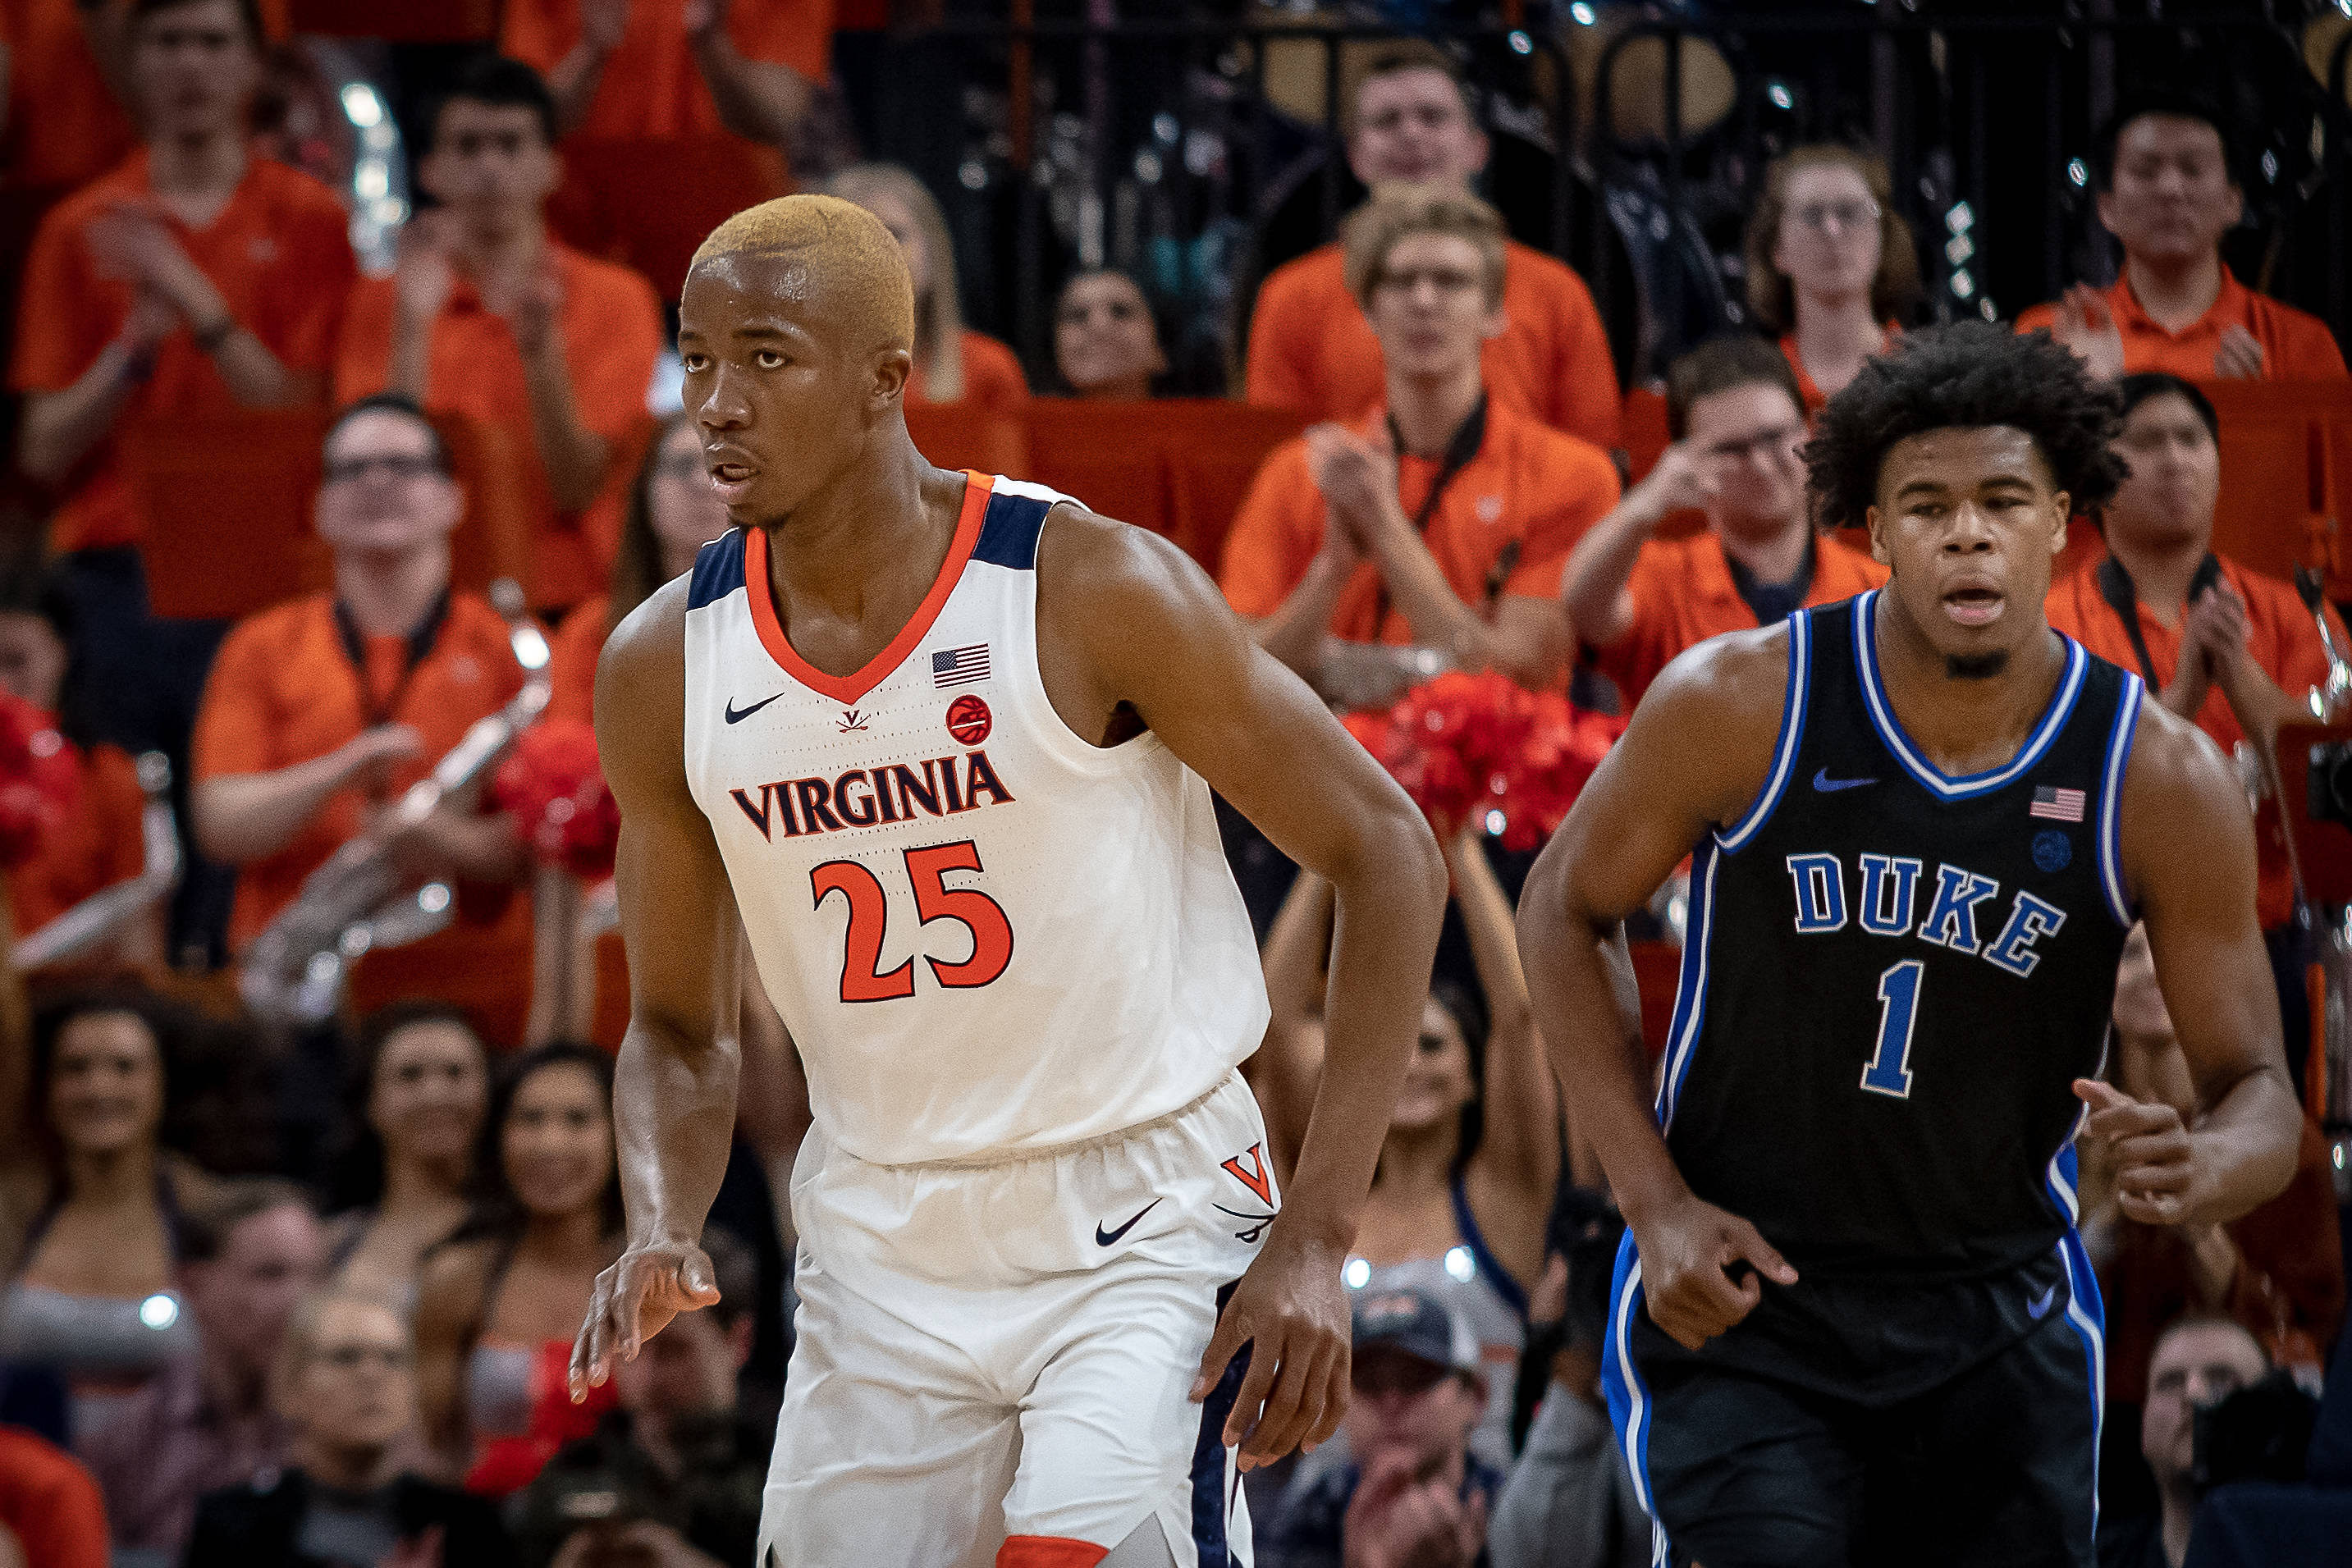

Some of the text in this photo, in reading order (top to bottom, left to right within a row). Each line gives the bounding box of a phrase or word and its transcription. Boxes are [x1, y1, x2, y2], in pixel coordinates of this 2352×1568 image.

[729, 750, 1016, 843] VIRGINIA
[809, 839, 1014, 1003] 25
[1787, 853, 2066, 978] DUKE
[1860, 958, 1924, 1099] 1
[1220, 1141, 1274, 1209] V
